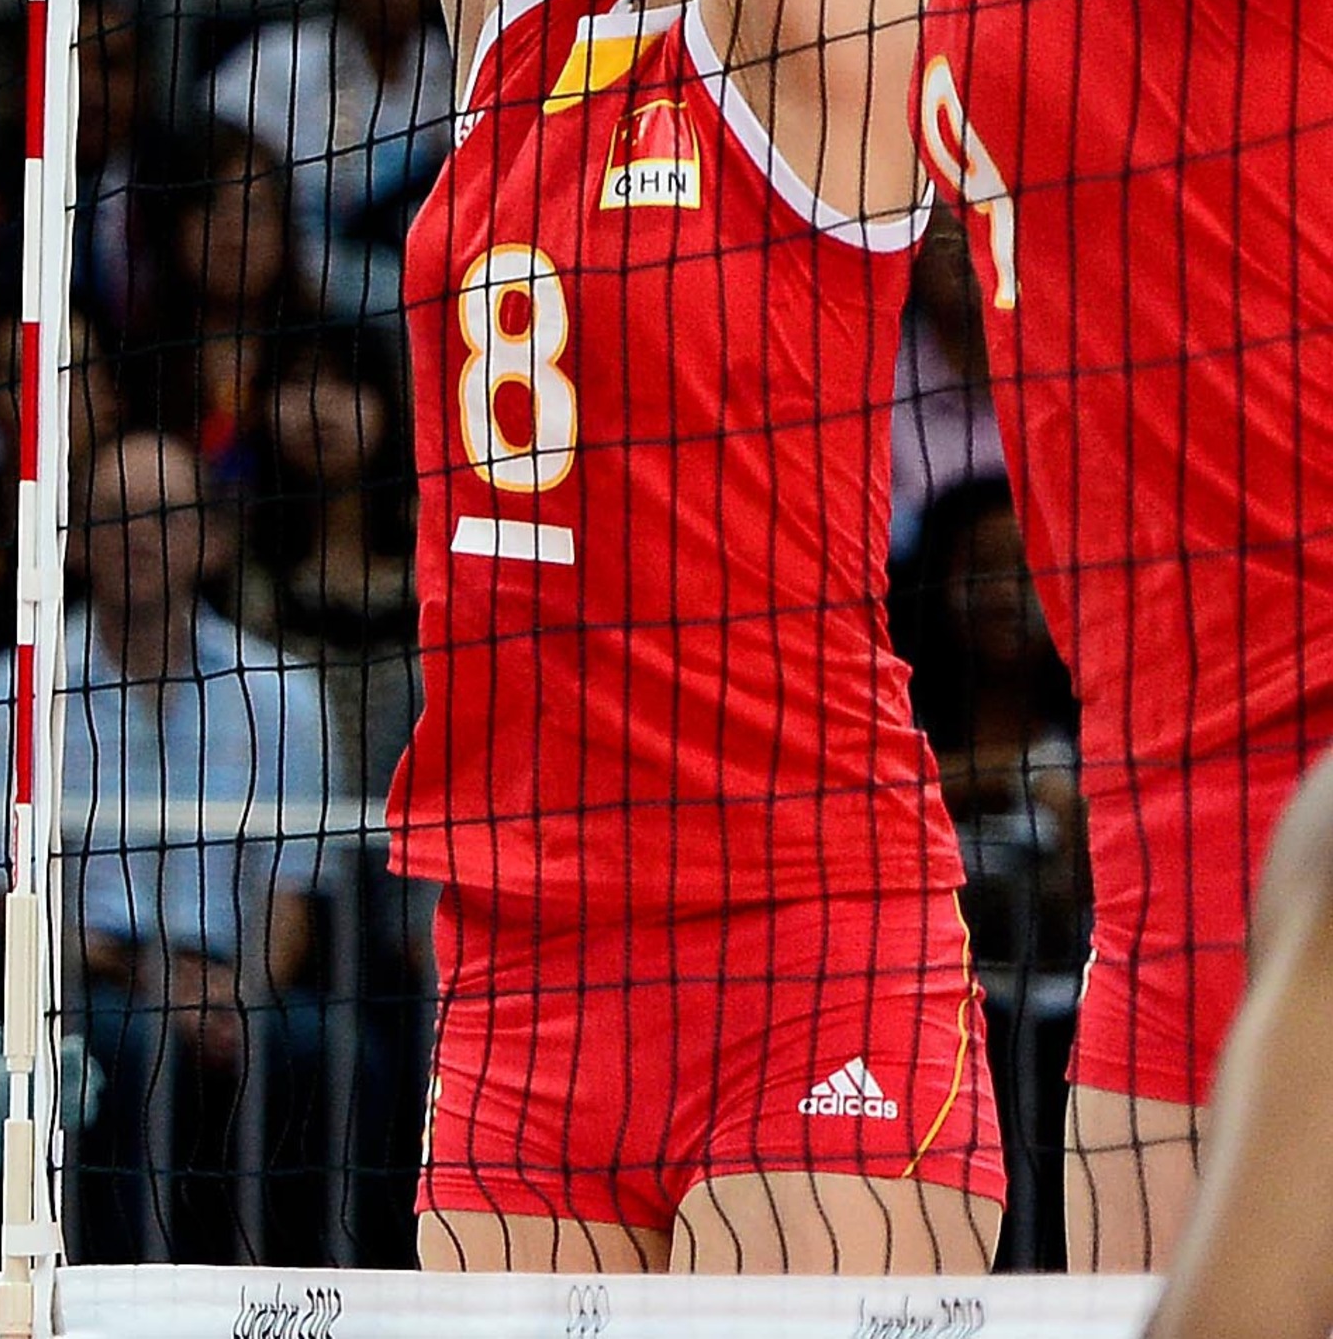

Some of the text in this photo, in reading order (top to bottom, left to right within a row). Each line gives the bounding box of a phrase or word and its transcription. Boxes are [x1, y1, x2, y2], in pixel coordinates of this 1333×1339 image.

[614, 170, 687, 196] CHN
[921, 54, 1022, 310] 9
[459, 244, 578, 494] 8
[798, 1092, 898, 1119] adidas
[233, 1282, 299, 1339] London
